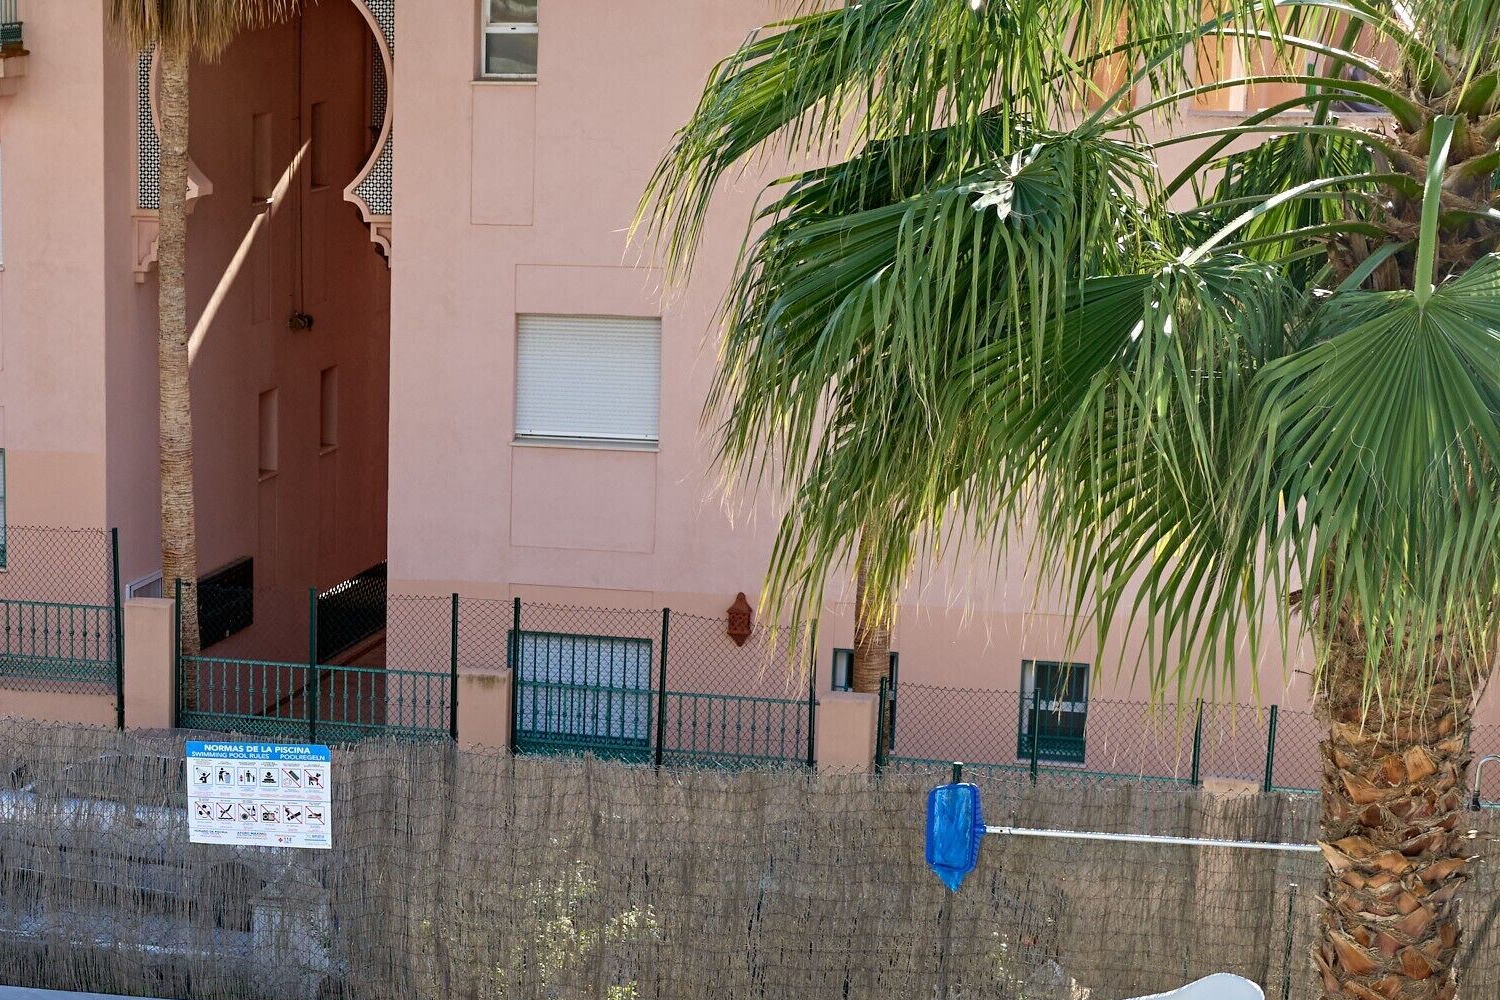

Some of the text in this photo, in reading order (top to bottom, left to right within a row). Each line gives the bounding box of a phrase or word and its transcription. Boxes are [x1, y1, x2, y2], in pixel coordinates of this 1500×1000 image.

[204, 744, 244, 753] NORMAS
[246, 745, 259, 753] DE
[274, 746, 311, 754] PISCINA
